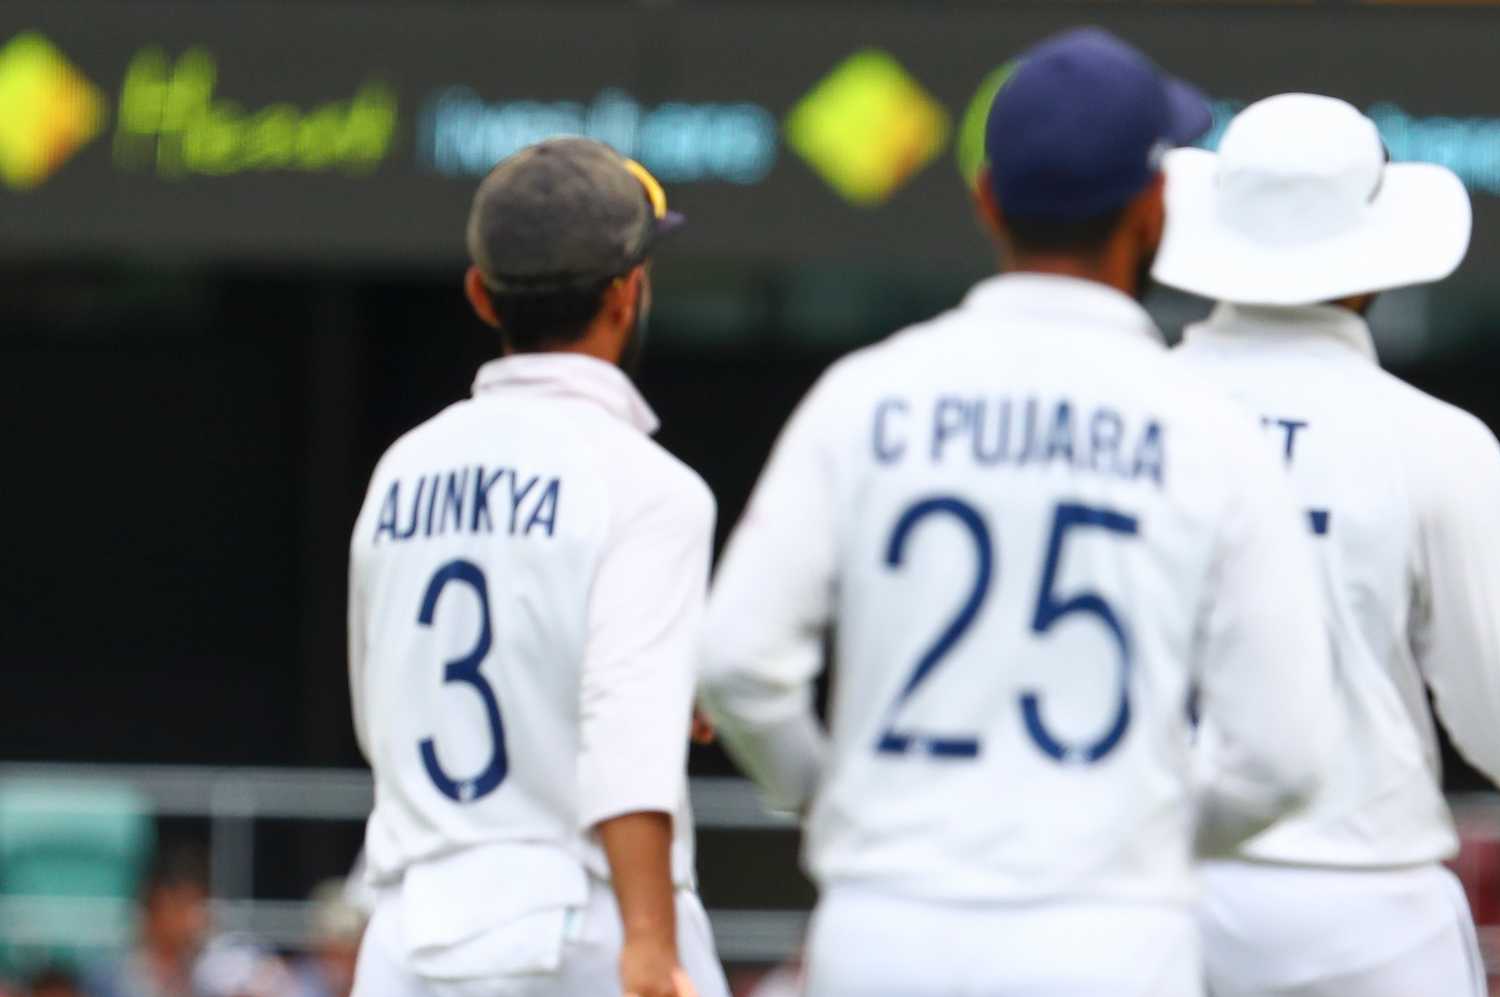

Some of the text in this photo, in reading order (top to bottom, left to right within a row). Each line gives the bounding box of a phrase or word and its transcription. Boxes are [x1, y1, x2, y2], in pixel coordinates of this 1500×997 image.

[374, 464, 562, 547] AJINKYA
[872, 396, 1166, 488] C PUJARA
[417, 558, 509, 803] 3
[874, 496, 1139, 765] 25
